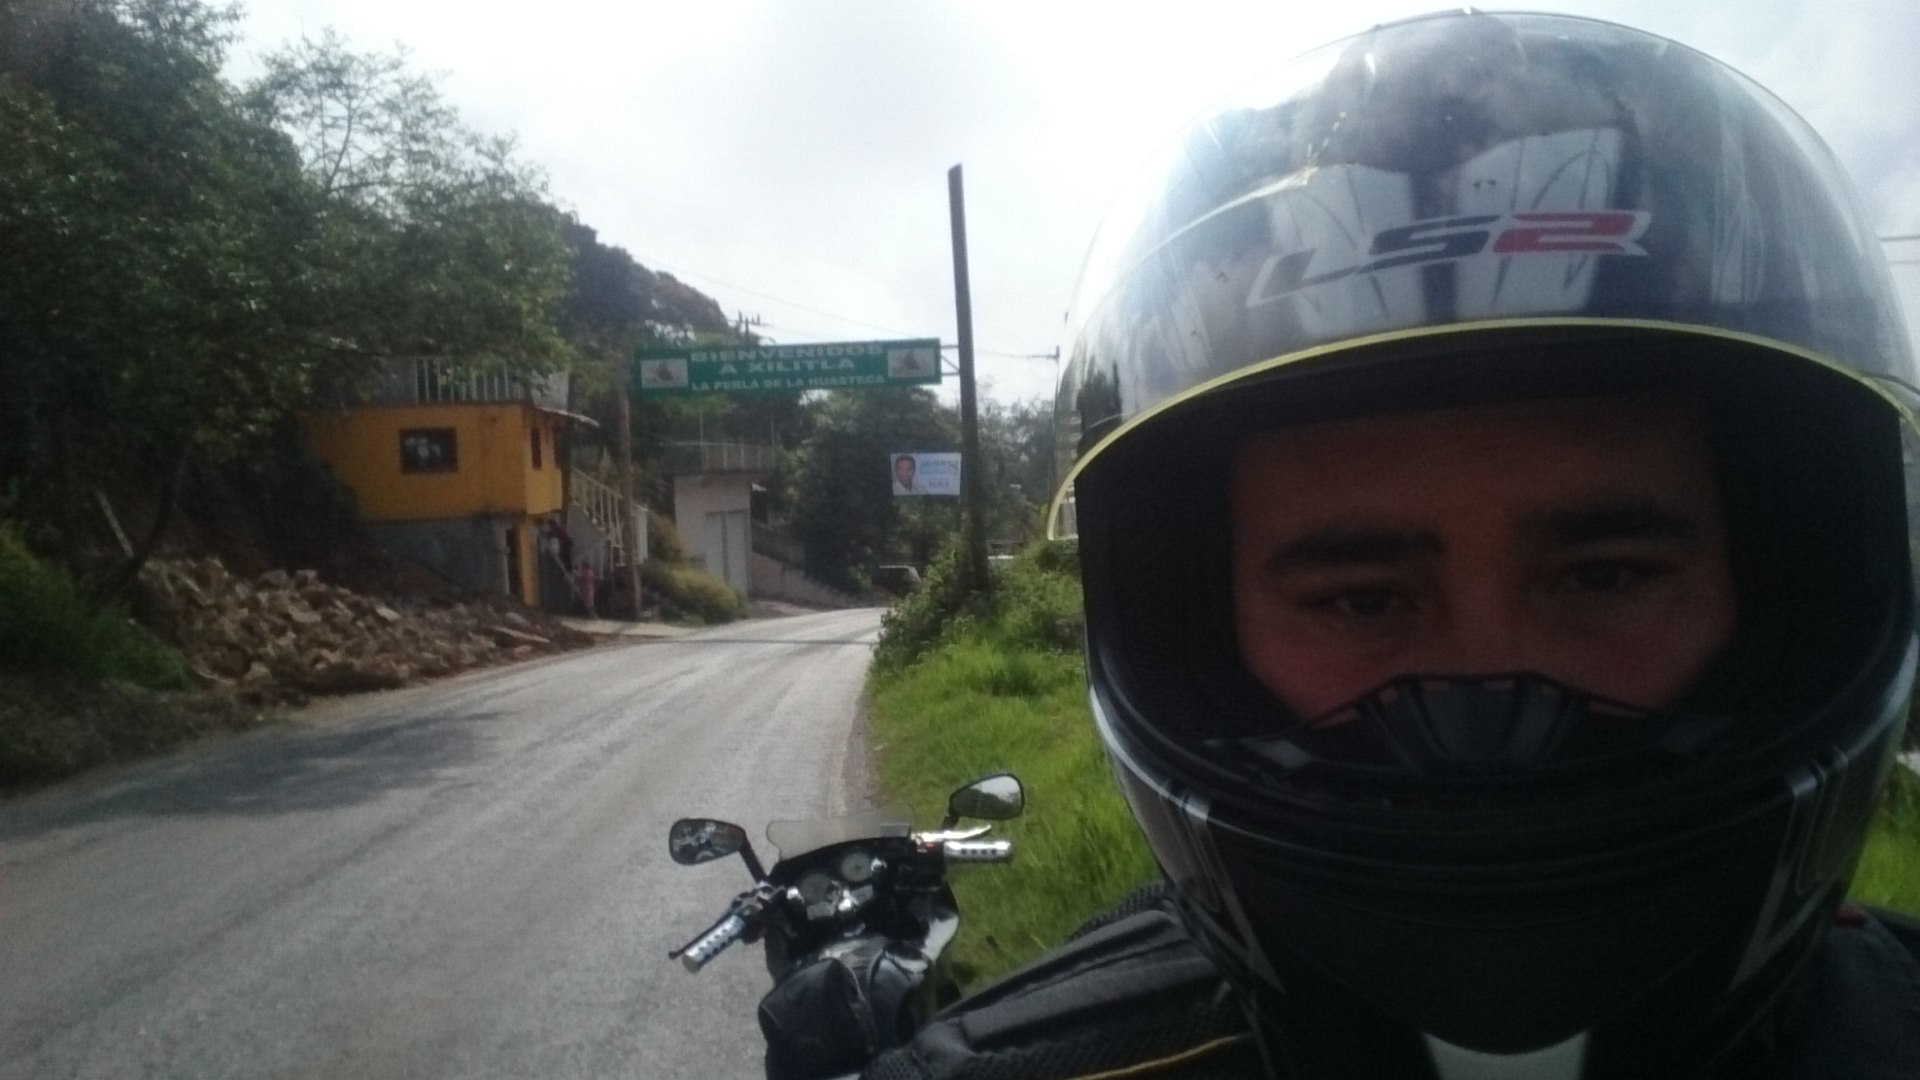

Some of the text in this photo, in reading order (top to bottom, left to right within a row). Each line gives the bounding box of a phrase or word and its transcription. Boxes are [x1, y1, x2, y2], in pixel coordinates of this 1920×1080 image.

[1246, 211, 1652, 308] LS2
[690, 344, 884, 362] BIENVENIDOS
[718, 359, 855, 375] A XILITLA
[692, 374, 885, 391] LA PERLA DE LA HUASTECA
